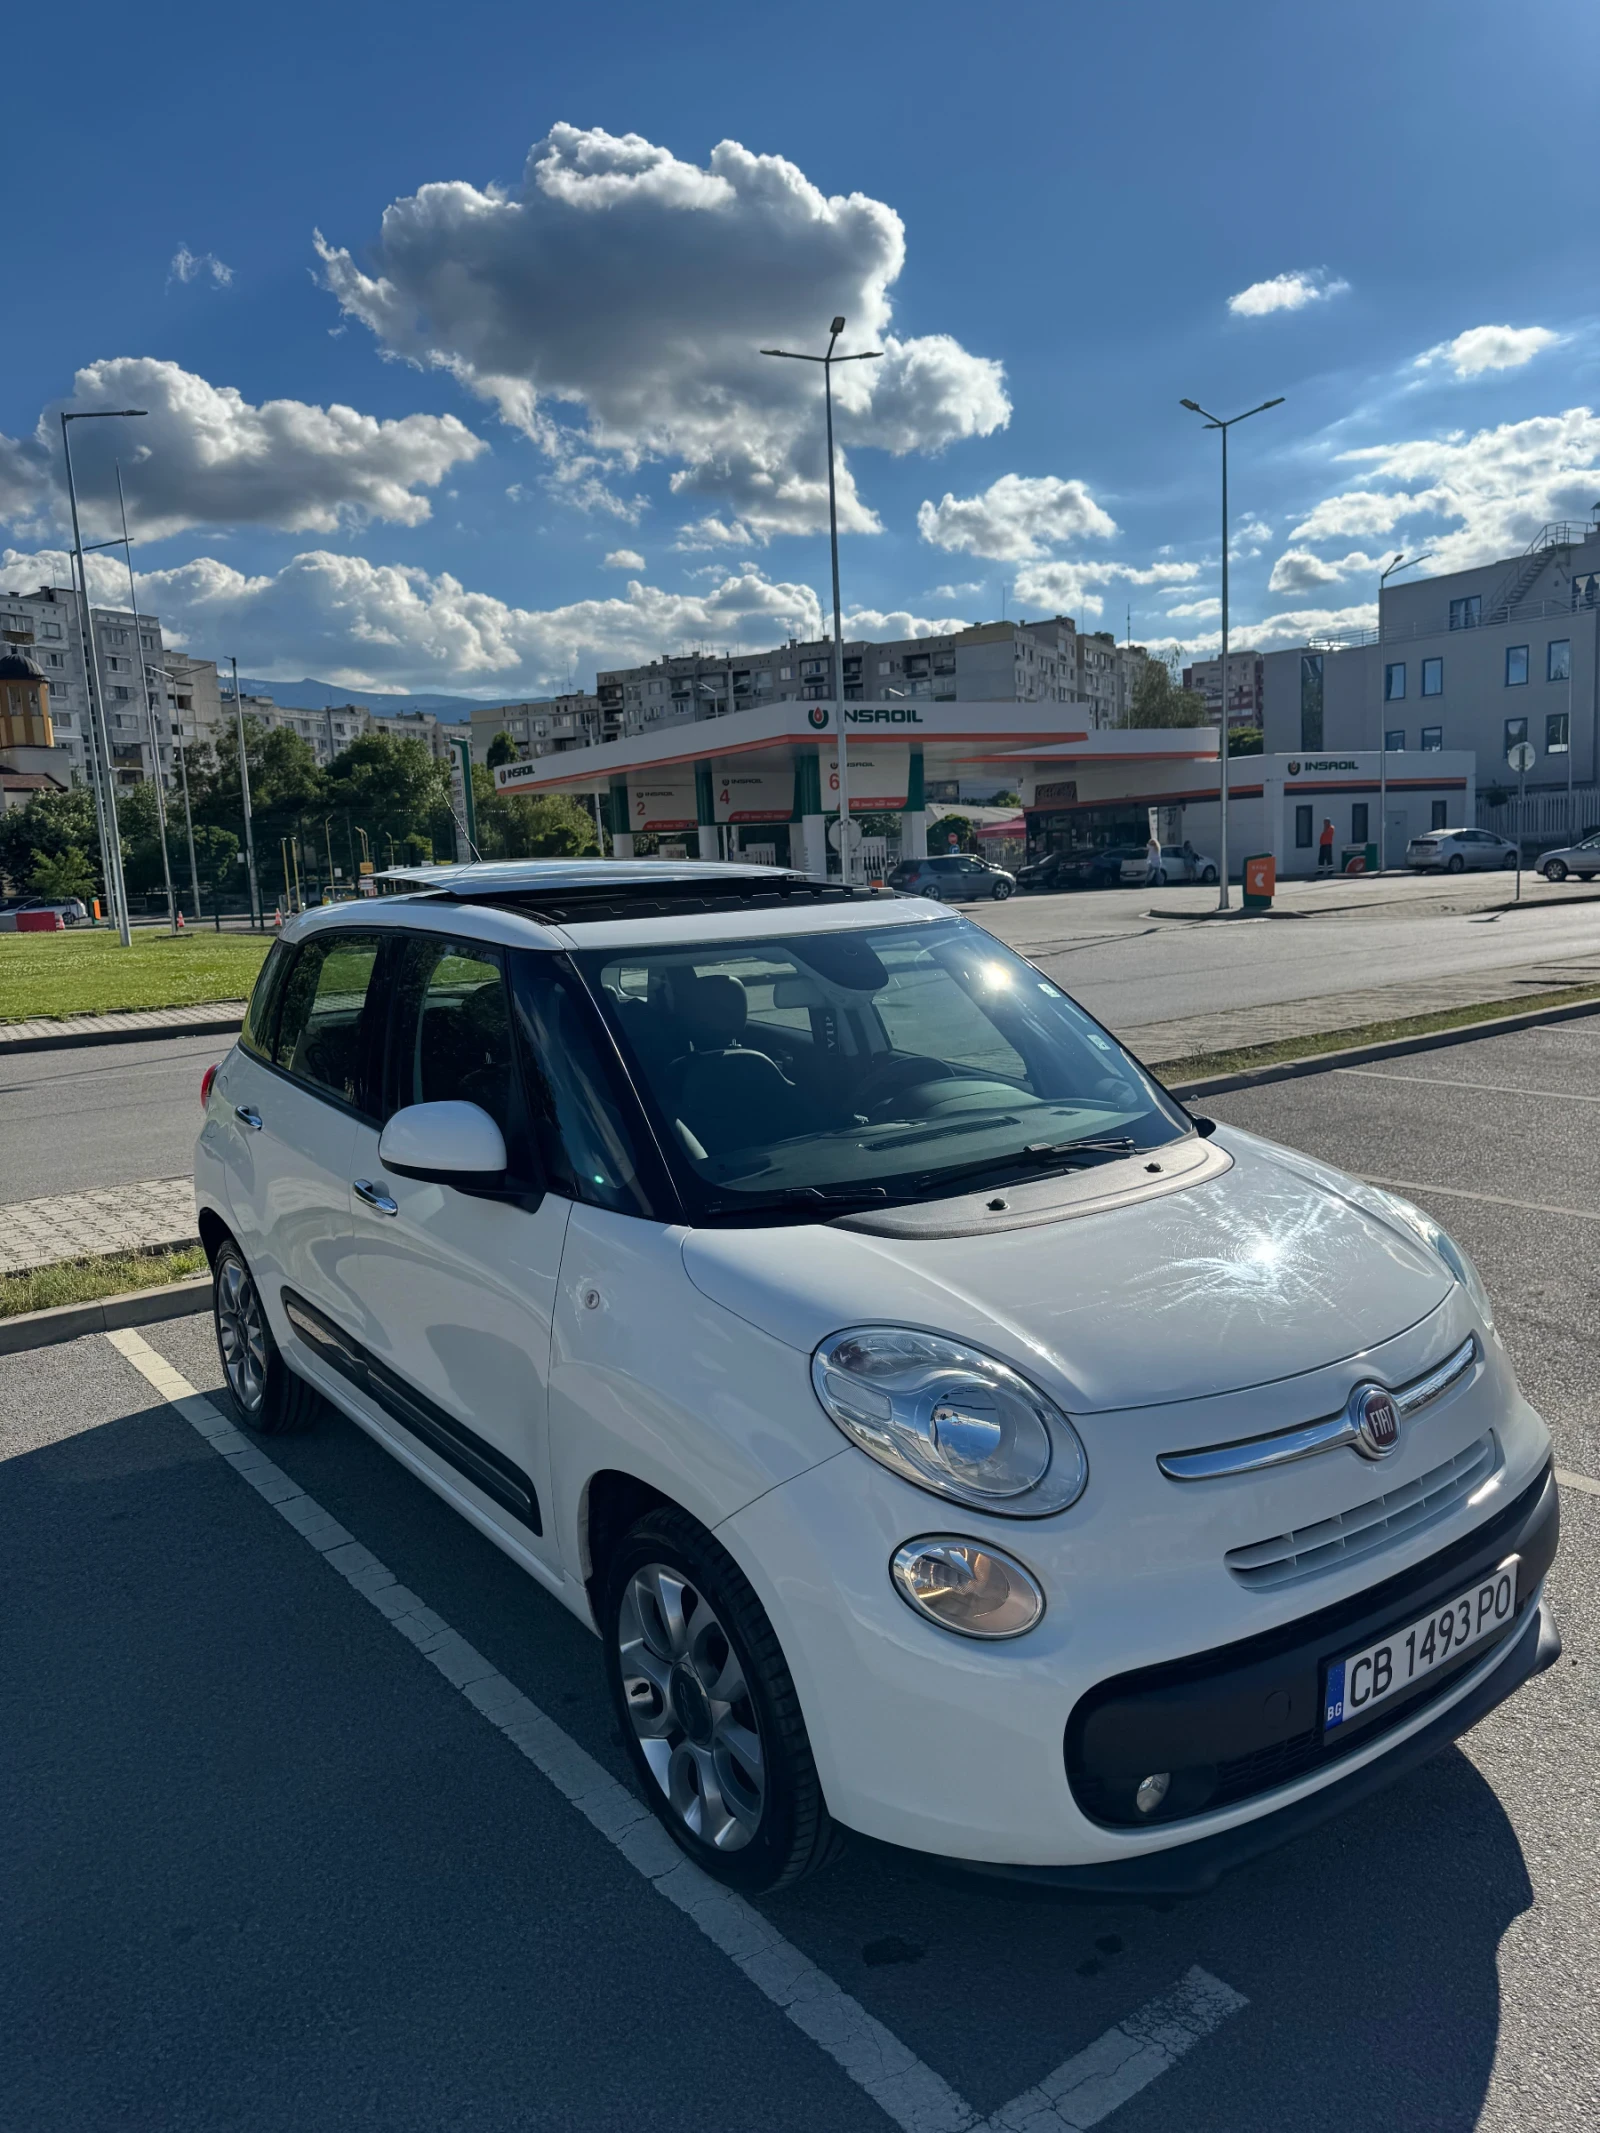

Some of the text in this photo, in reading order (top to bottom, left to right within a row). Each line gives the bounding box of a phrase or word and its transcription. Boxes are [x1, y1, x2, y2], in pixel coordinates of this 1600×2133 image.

[844, 709, 923, 723] NSAOIL
[1304, 761, 1359, 771] INSAOIL
[829, 773, 840, 791] 6
[720, 789, 730, 805] 4
[636, 801, 646, 816] 2
[1369, 1405, 1394, 1438] FIAT
[1350, 1646, 1393, 1708] CB
[1406, 1600, 1471, 1677] 1493
[1327, 1702, 1342, 1720] BG
